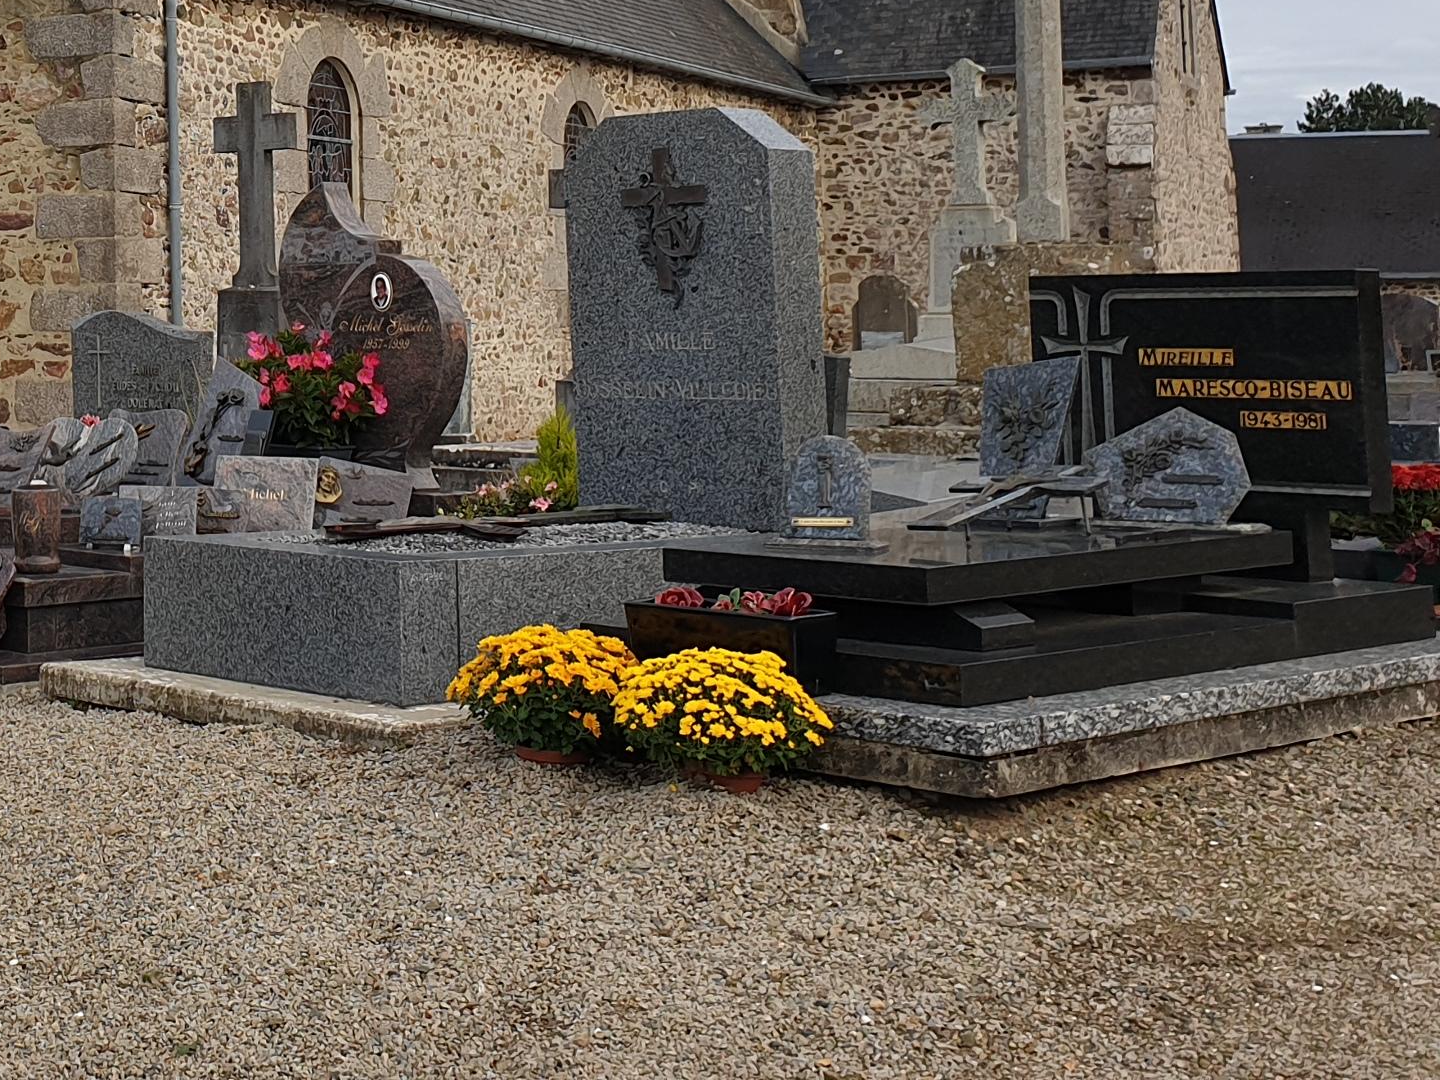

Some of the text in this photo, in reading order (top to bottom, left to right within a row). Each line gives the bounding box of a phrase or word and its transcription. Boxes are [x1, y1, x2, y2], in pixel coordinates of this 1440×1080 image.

[340, 313, 433, 336] Michel Gosselin
[363, 338, 410, 349] 1957-1999
[1158, 379, 1351, 399] MARESCQ-BISEAU
[1241, 411, 1325, 429] 1943-1981
